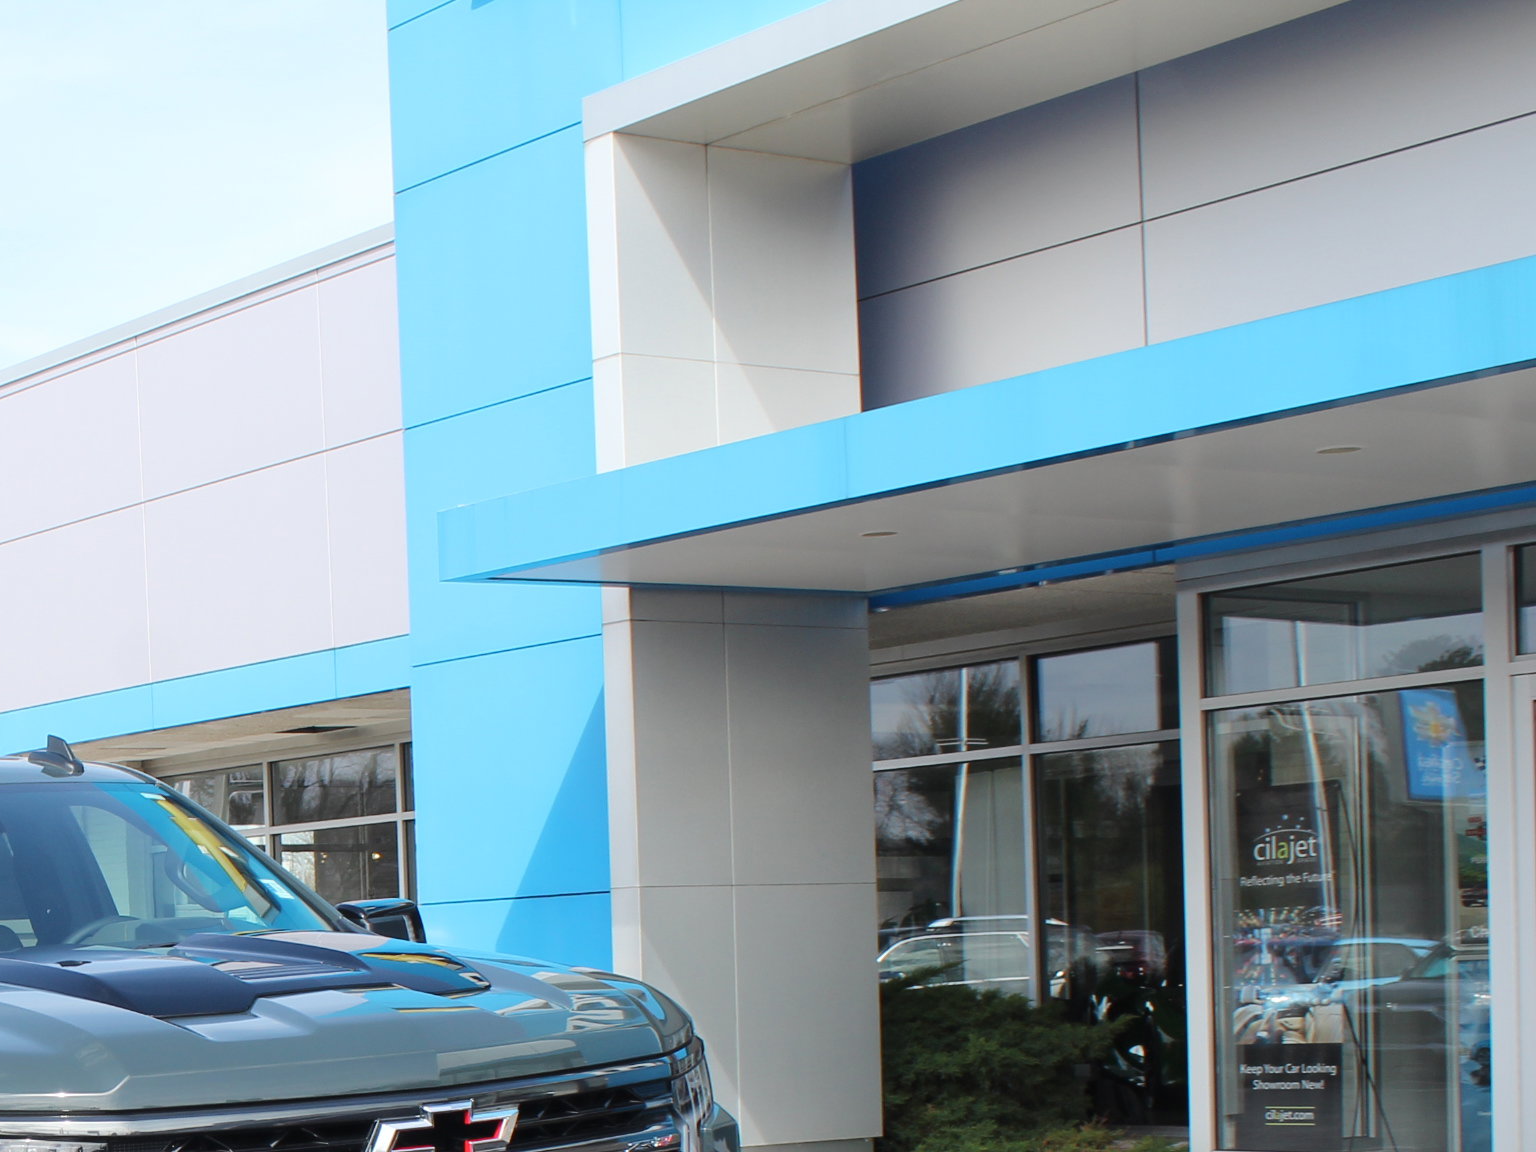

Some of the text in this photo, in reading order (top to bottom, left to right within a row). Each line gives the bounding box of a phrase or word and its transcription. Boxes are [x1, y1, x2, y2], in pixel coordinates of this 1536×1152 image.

[1253, 835, 1318, 864] cilajet
[1239, 874, 1285, 887] Reflecting
[1286, 873, 1301, 884] the
[1239, 1062, 1337, 1076] Keep Your Car Looking
[1252, 1079, 1300, 1090] Showroom
[1264, 1109, 1315, 1122] cilajet.com
